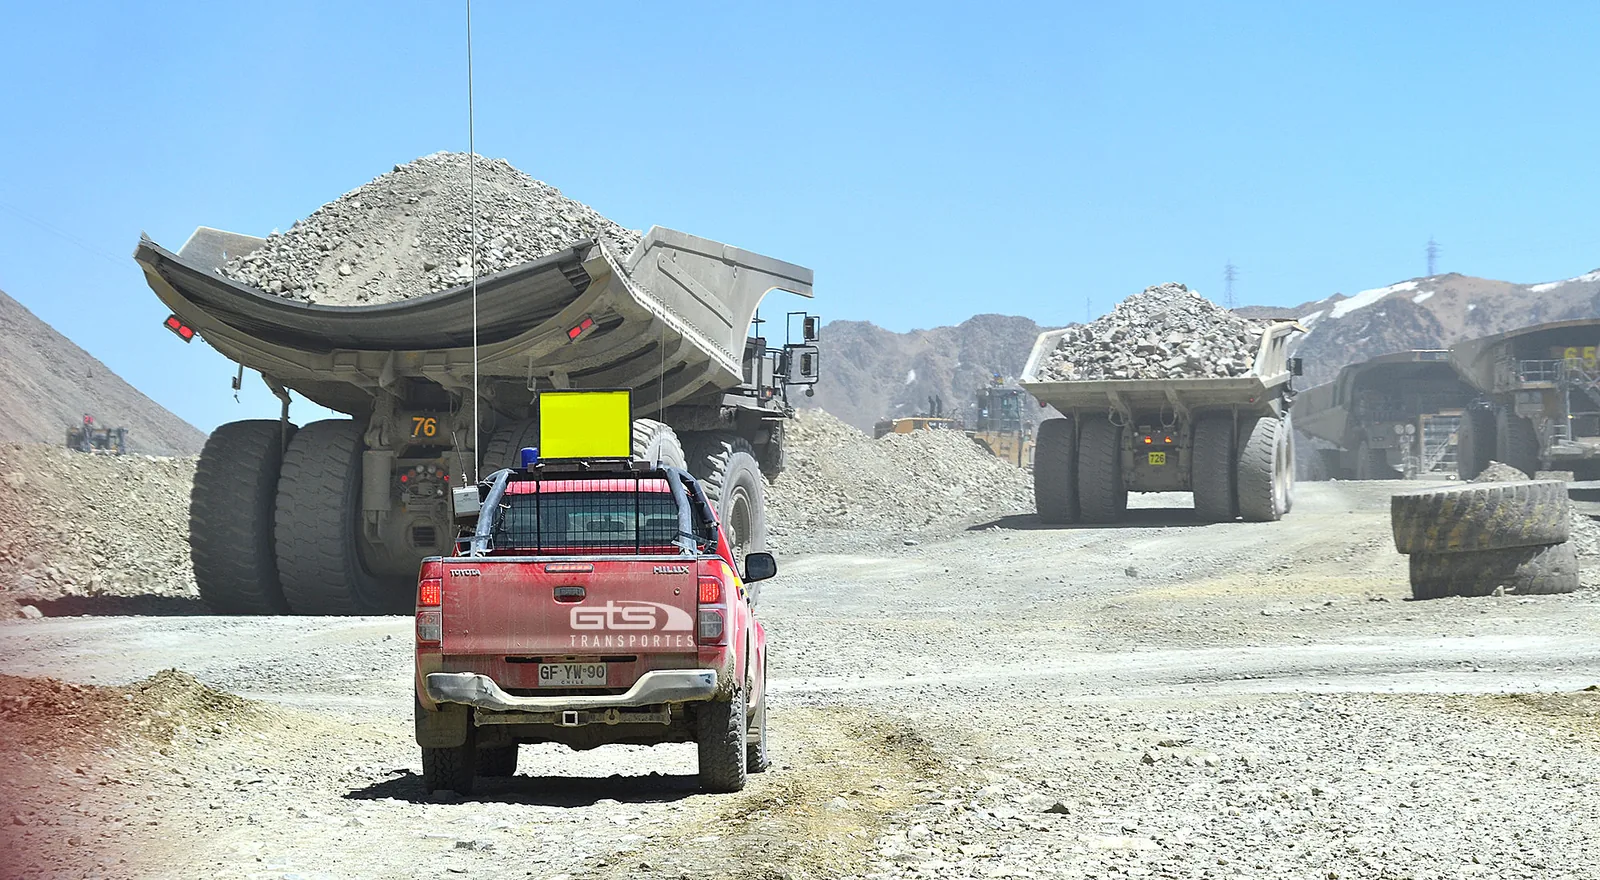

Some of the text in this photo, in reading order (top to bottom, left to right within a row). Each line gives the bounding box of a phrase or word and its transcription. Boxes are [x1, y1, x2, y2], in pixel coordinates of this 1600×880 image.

[412, 417, 437, 437] 76
[450, 568, 482, 577] TOYOTA
[653, 565, 690, 574] HILUX
[570, 635, 693, 647] TRANSPORTES
